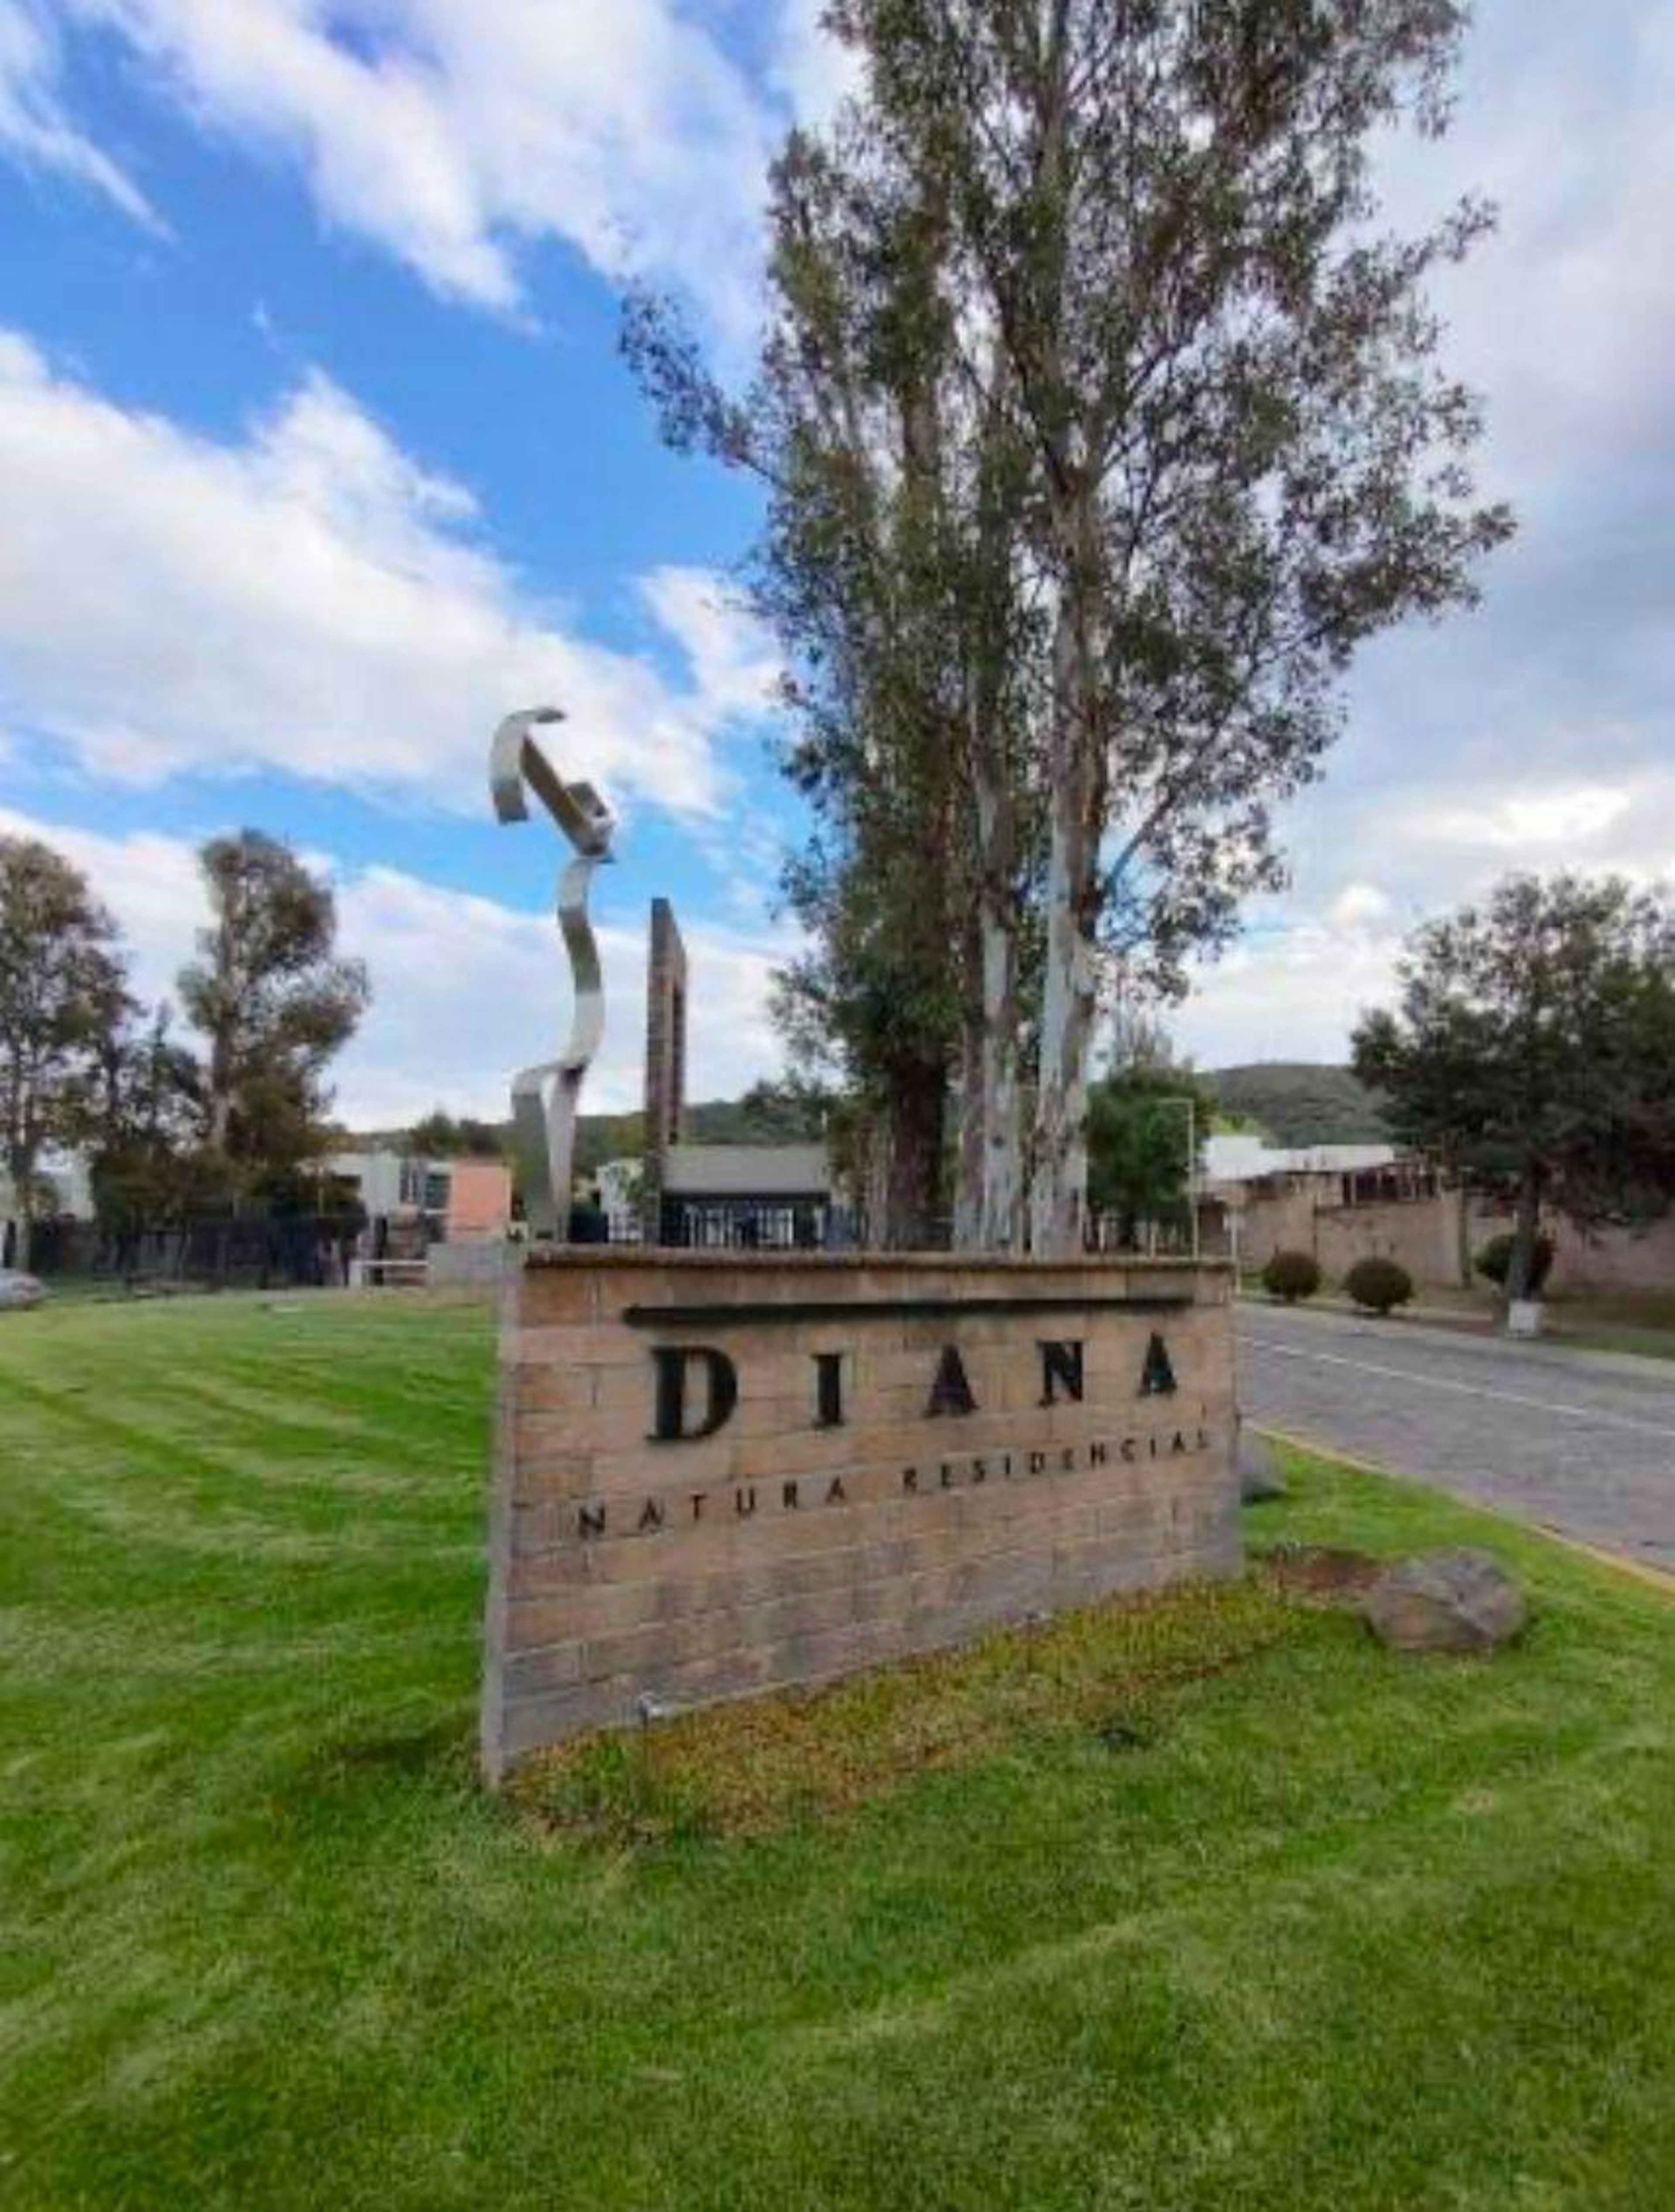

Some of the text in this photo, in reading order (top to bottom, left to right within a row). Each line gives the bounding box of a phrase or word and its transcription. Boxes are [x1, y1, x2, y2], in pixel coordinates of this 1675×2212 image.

[644, 1330, 1178, 1443] DIANA
[578, 1429, 1209, 1539] NATURA RESIDENCIAL
